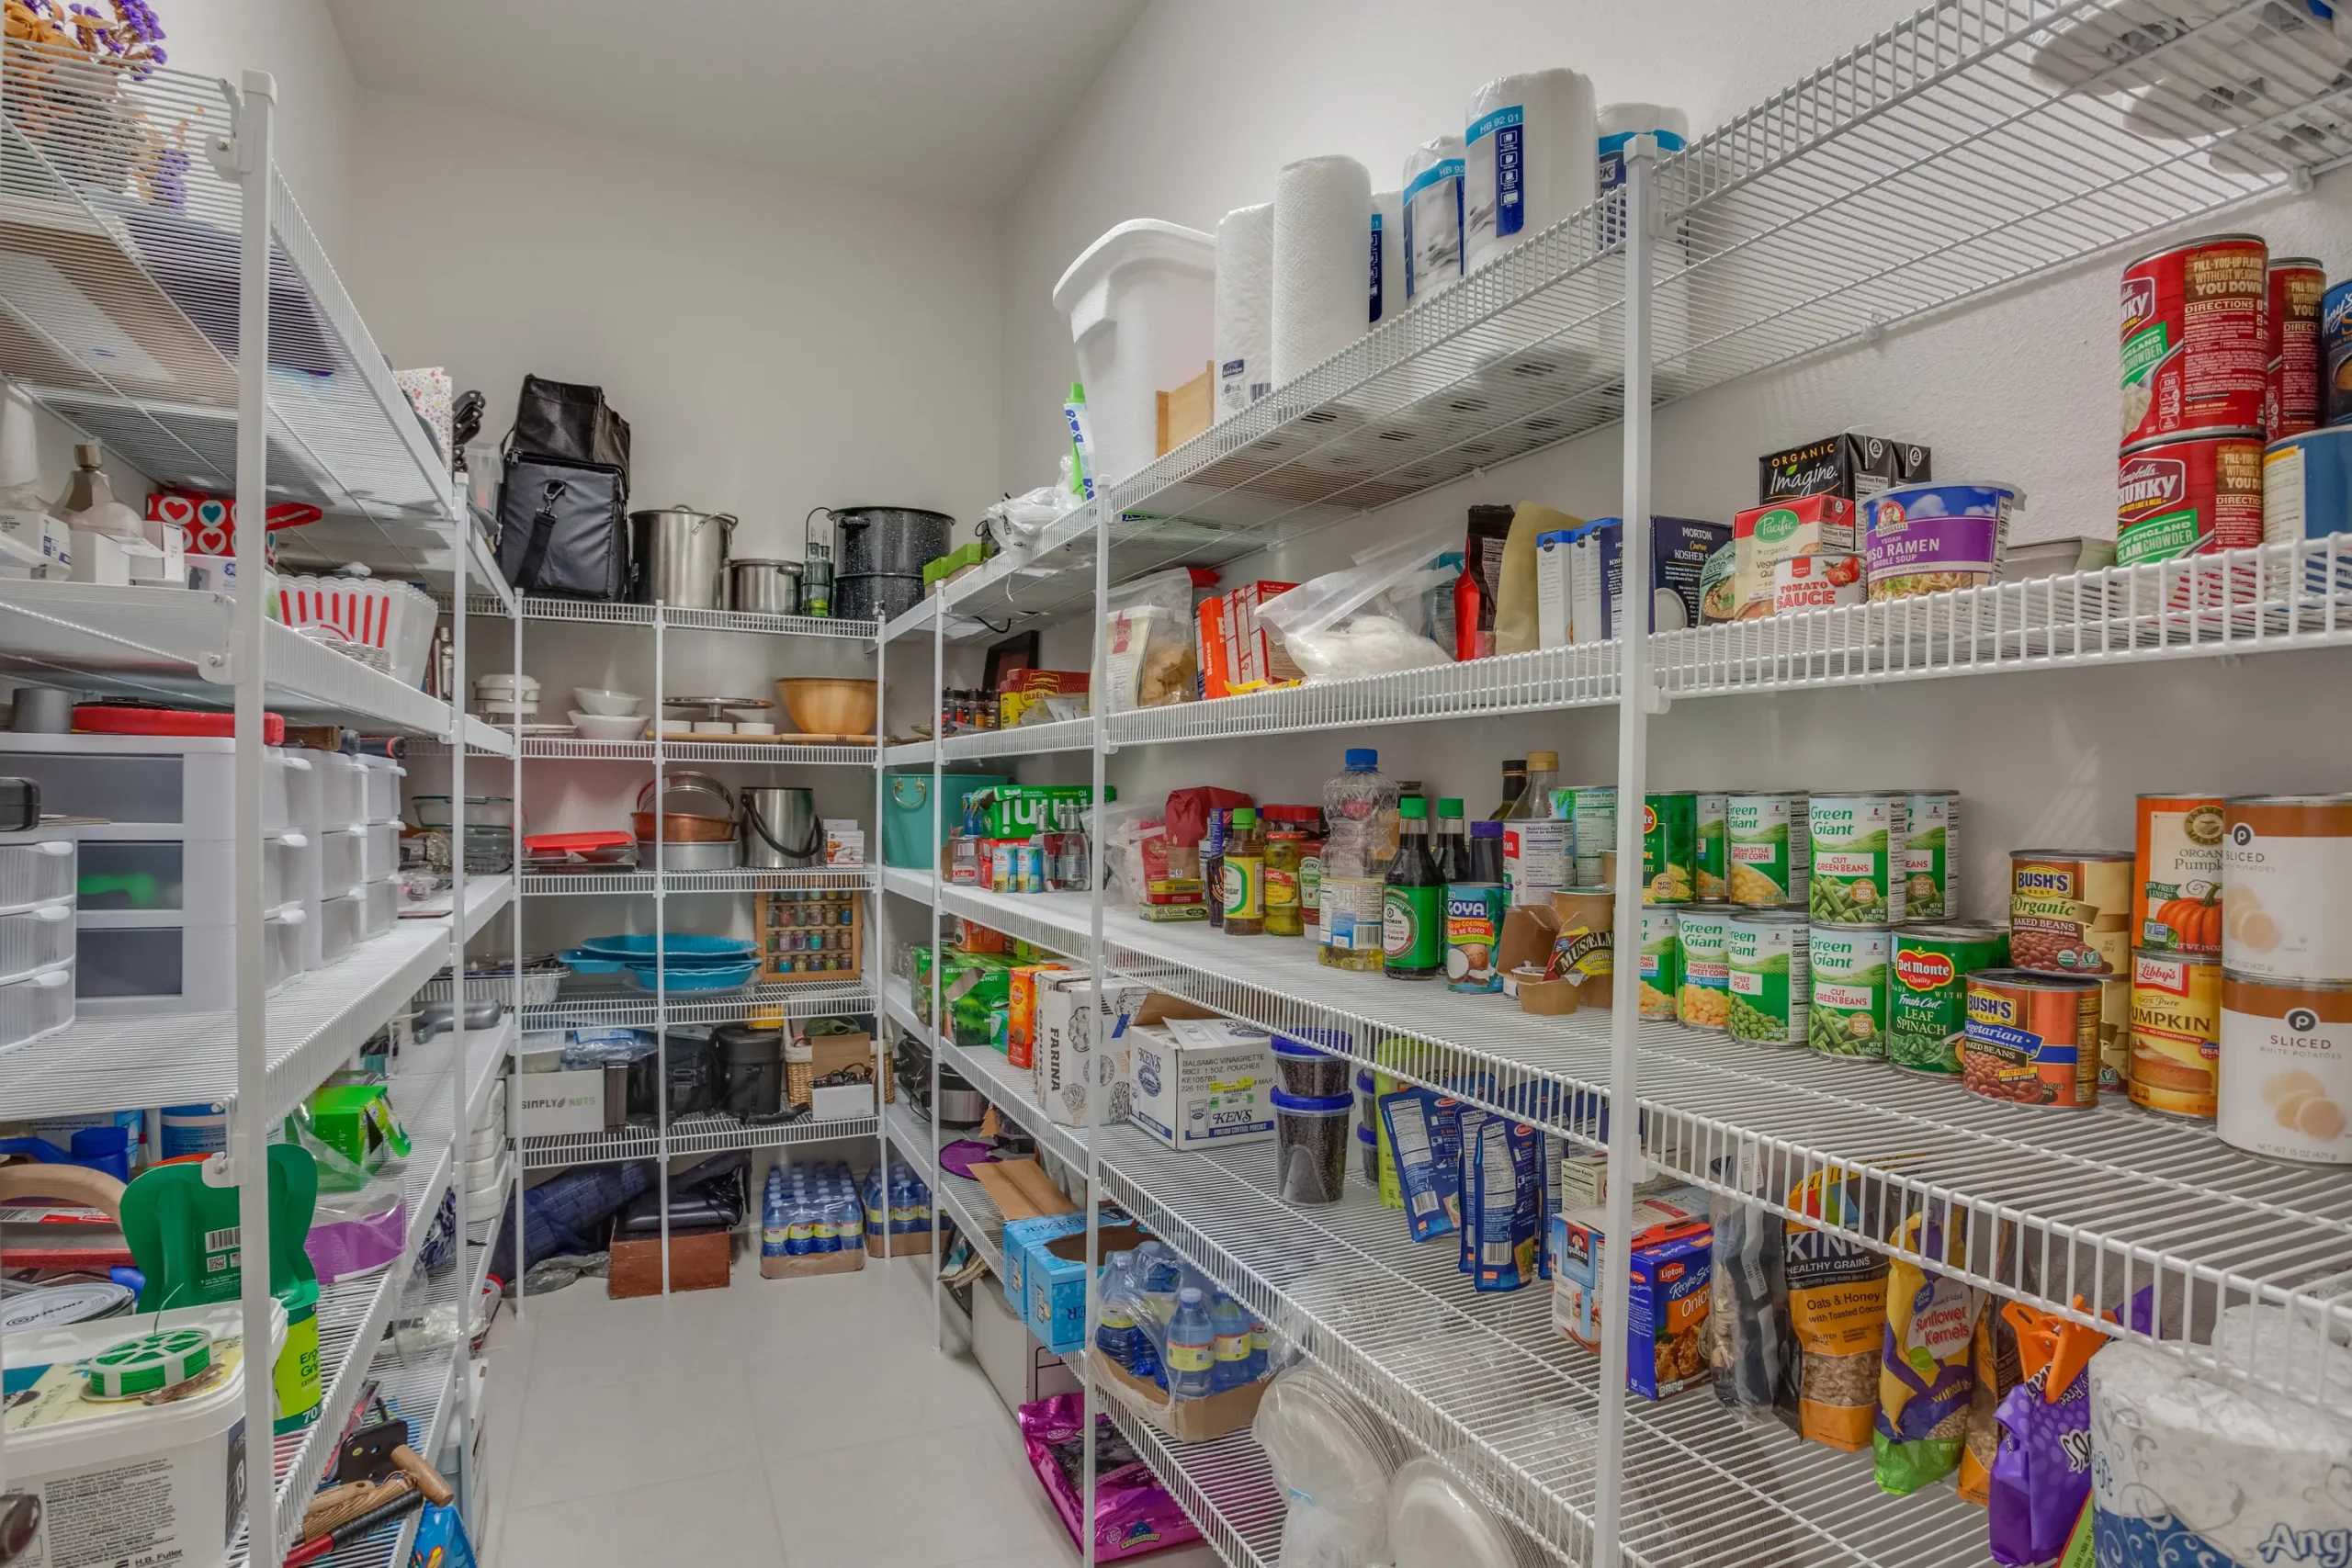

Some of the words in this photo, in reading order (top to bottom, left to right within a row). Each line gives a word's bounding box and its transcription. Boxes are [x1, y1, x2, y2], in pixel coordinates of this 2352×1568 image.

[1480, 121, 1492, 134] HB
[1494, 117, 1505, 127] 92
[1508, 113, 1519, 124] 01
[1439, 167, 1452, 177] HB
[2196, 283, 2227, 296] YOU
[2228, 281, 2262, 293] DOWN
[2185, 300, 2254, 314] DIRECTIONS
[1772, 443, 1835, 468] ORGANIC
[2226, 478, 2252, 489] YOU
[1758, 516, 1794, 536] Pacific
[2133, 521, 2191, 541] ENGLAND
[1682, 527, 1712, 541] MORTON
[1881, 536, 1901, 544] VEGAN
[2143, 530, 2193, 551] CHOWDER
[1887, 538, 1940, 557] RAMEN
[1674, 549, 1704, 562] KOSHER
[1896, 554, 1917, 564] SOUP
[1780, 581, 1828, 593] TOMATO
[1776, 590, 1836, 609] SAUCE
[1810, 806, 1853, 820] Green
[1814, 822, 1854, 835] Giant
[953, 869, 970, 878] Coke
[2018, 872, 2068, 891] BUSH'S
[2158, 882, 2176, 892] FREE
[1447, 901, 1486, 915] GOYA
[2014, 897, 2076, 916] Organic
[1681, 919, 1723, 935] Green
[2014, 917, 2037, 927] BAKED
[2039, 919, 2075, 931] BEANS
[1685, 933, 1724, 948] Giant
[1811, 936, 1852, 953] Green
[1813, 952, 1854, 969] Giant
[1898, 959, 1912, 972] Del
[1913, 963, 1950, 976] Monte
[2139, 962, 2176, 982] Libby's
[1687, 976, 1702, 985] 50%
[1734, 982, 1750, 991] PEAS
[1909, 975, 1931, 985] Quality
[1816, 993, 1838, 1003] GREEN
[1840, 997, 1867, 1006] BEANS
[1899, 993, 1920, 1007] Fresh
[1920, 997, 1945, 1009] Cut
[1968, 994, 2012, 1020] BUSH'S
[2156, 997, 2180, 1007] Pure
[1905, 1006, 1934, 1022] LEAF
[1897, 1017, 1947, 1035] SPINACH
[1965, 1020, 2023, 1043] Vegetarian
[2157, 1030, 2202, 1043] PRESERVATIVES
[2270, 1034, 2332, 1049] SLICED
[1984, 1044, 2015, 1059] BEANS
[2201, 1048, 2219, 1056] USA
[2259, 1046, 2289, 1055] WHITE
[2293, 1050, 2342, 1060] POTATOES
[1050, 1027, 1061, 1092] FARINA
[1137, 1047, 1161, 1073] KEN'S
[1182, 1058, 1218, 1067] BALSAMIC
[1220, 1054, 1265, 1064] VINAIGRETTE
[1227, 1063, 1260, 1072] POUCHES
[521, 1099, 558, 1110] SIMPLY
[568, 1096, 596, 1106] NUTS
[1212, 1109, 1253, 1124] KEN'S
[1214, 1127, 1231, 1136] PORTION
[1232, 1125, 1250, 1134] CONTROL
[1250, 1122, 1267, 1132] POUCHES
[2257, 1142, 2272, 1151] NET
[2274, 1145, 2286, 1155] WT
[1742, 1155, 1750, 1172] DATE
[1563, 1165, 1581, 1174] Nutrition
[1581, 1168, 1594, 1178] Facts
[1567, 1245, 1588, 1260] QUAKER
[1661, 1267, 1683, 1279] Lipton
[1745, 1263, 1753, 1280] DATE
[1786, 1261, 1830, 1275] HEALTHY
[1833, 1256, 1871, 1269] GRAINS
[1752, 1258, 1765, 1292] CONTENTS
[1823, 1276, 1837, 1286] you
[1670, 1276, 1698, 1299] Recipe
[1915, 1287, 1930, 1301] Great
[1807, 1298, 1832, 1311] Oats
[1834, 1295, 1842, 1305] &
[1843, 1292, 1880, 1303] Honey
[1917, 1297, 1929, 1307] Value
[1809, 1312, 1827, 1323] with
[1828, 1308, 1858, 1320] Toasted
[1916, 1306, 1967, 1333] Sunflower
[1924, 1322, 1970, 1347] Kernels
[1931, 1381, 1962, 1403] without
[2058, 1388, 2086, 1407] Free
[303, 1405, 318, 1424] 70
[135, 1557, 154, 1566] H.B.
[157, 1549, 183, 1560] Fuller
